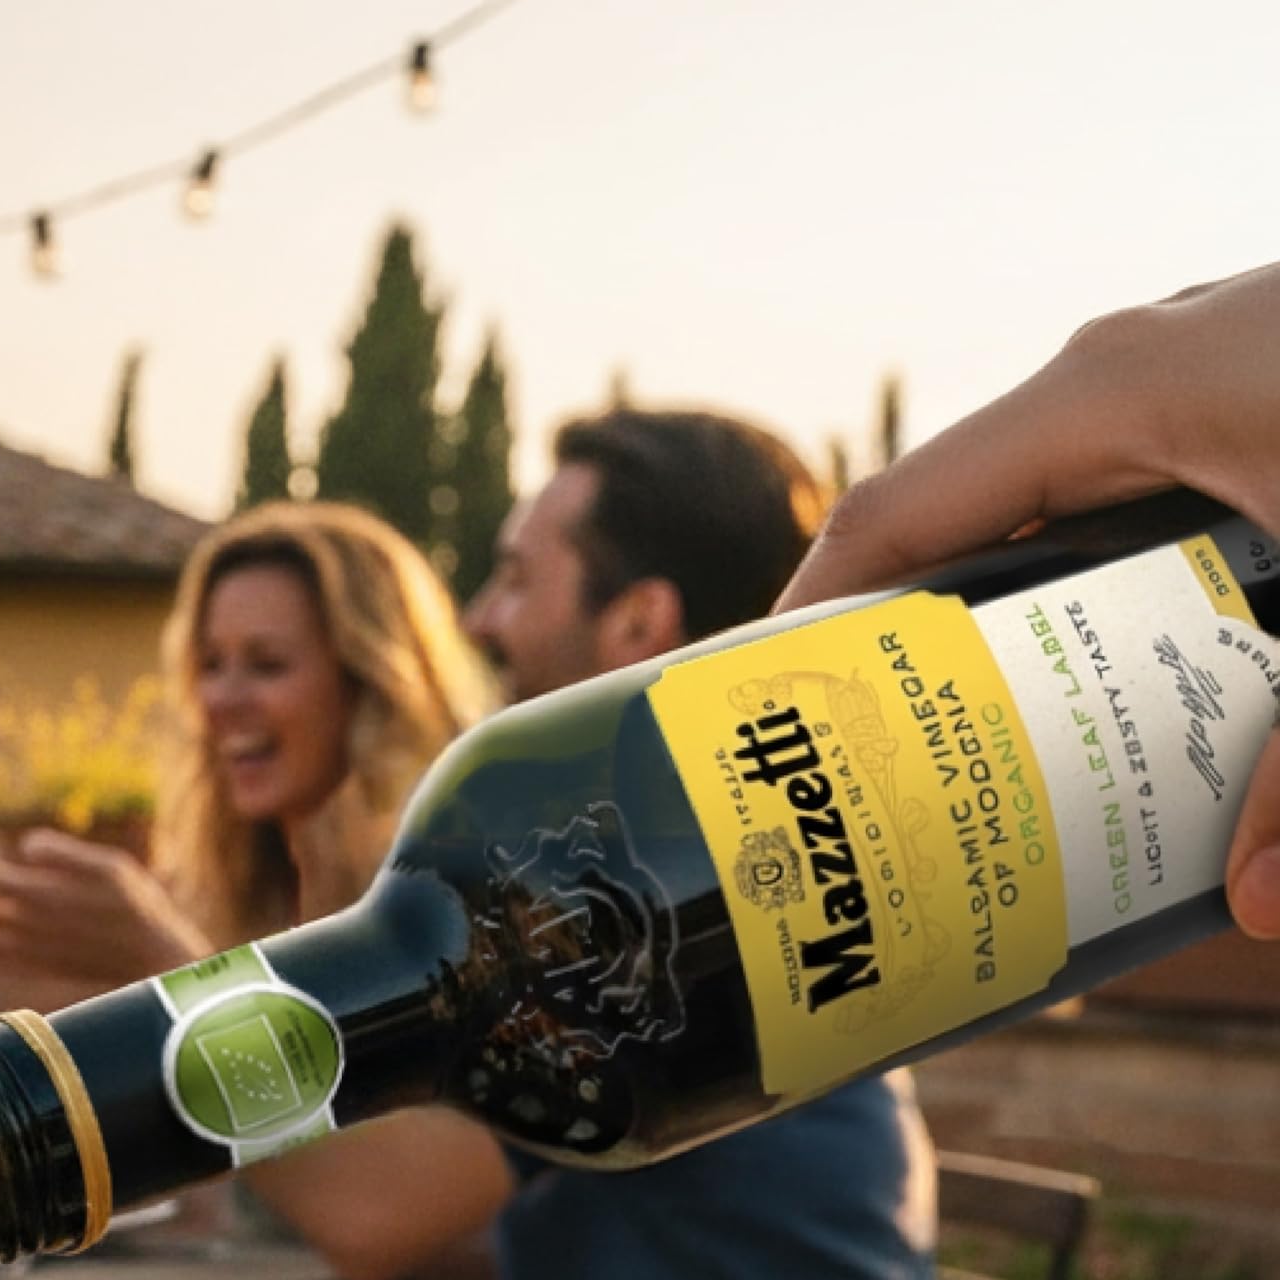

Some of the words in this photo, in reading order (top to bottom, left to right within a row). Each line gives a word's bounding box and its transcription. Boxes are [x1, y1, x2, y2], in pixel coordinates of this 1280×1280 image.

[734, 706, 880, 1014] Mazzetti
[982, 703, 1045, 866] ORGANIC
[992, 864, 1018, 907] OF
